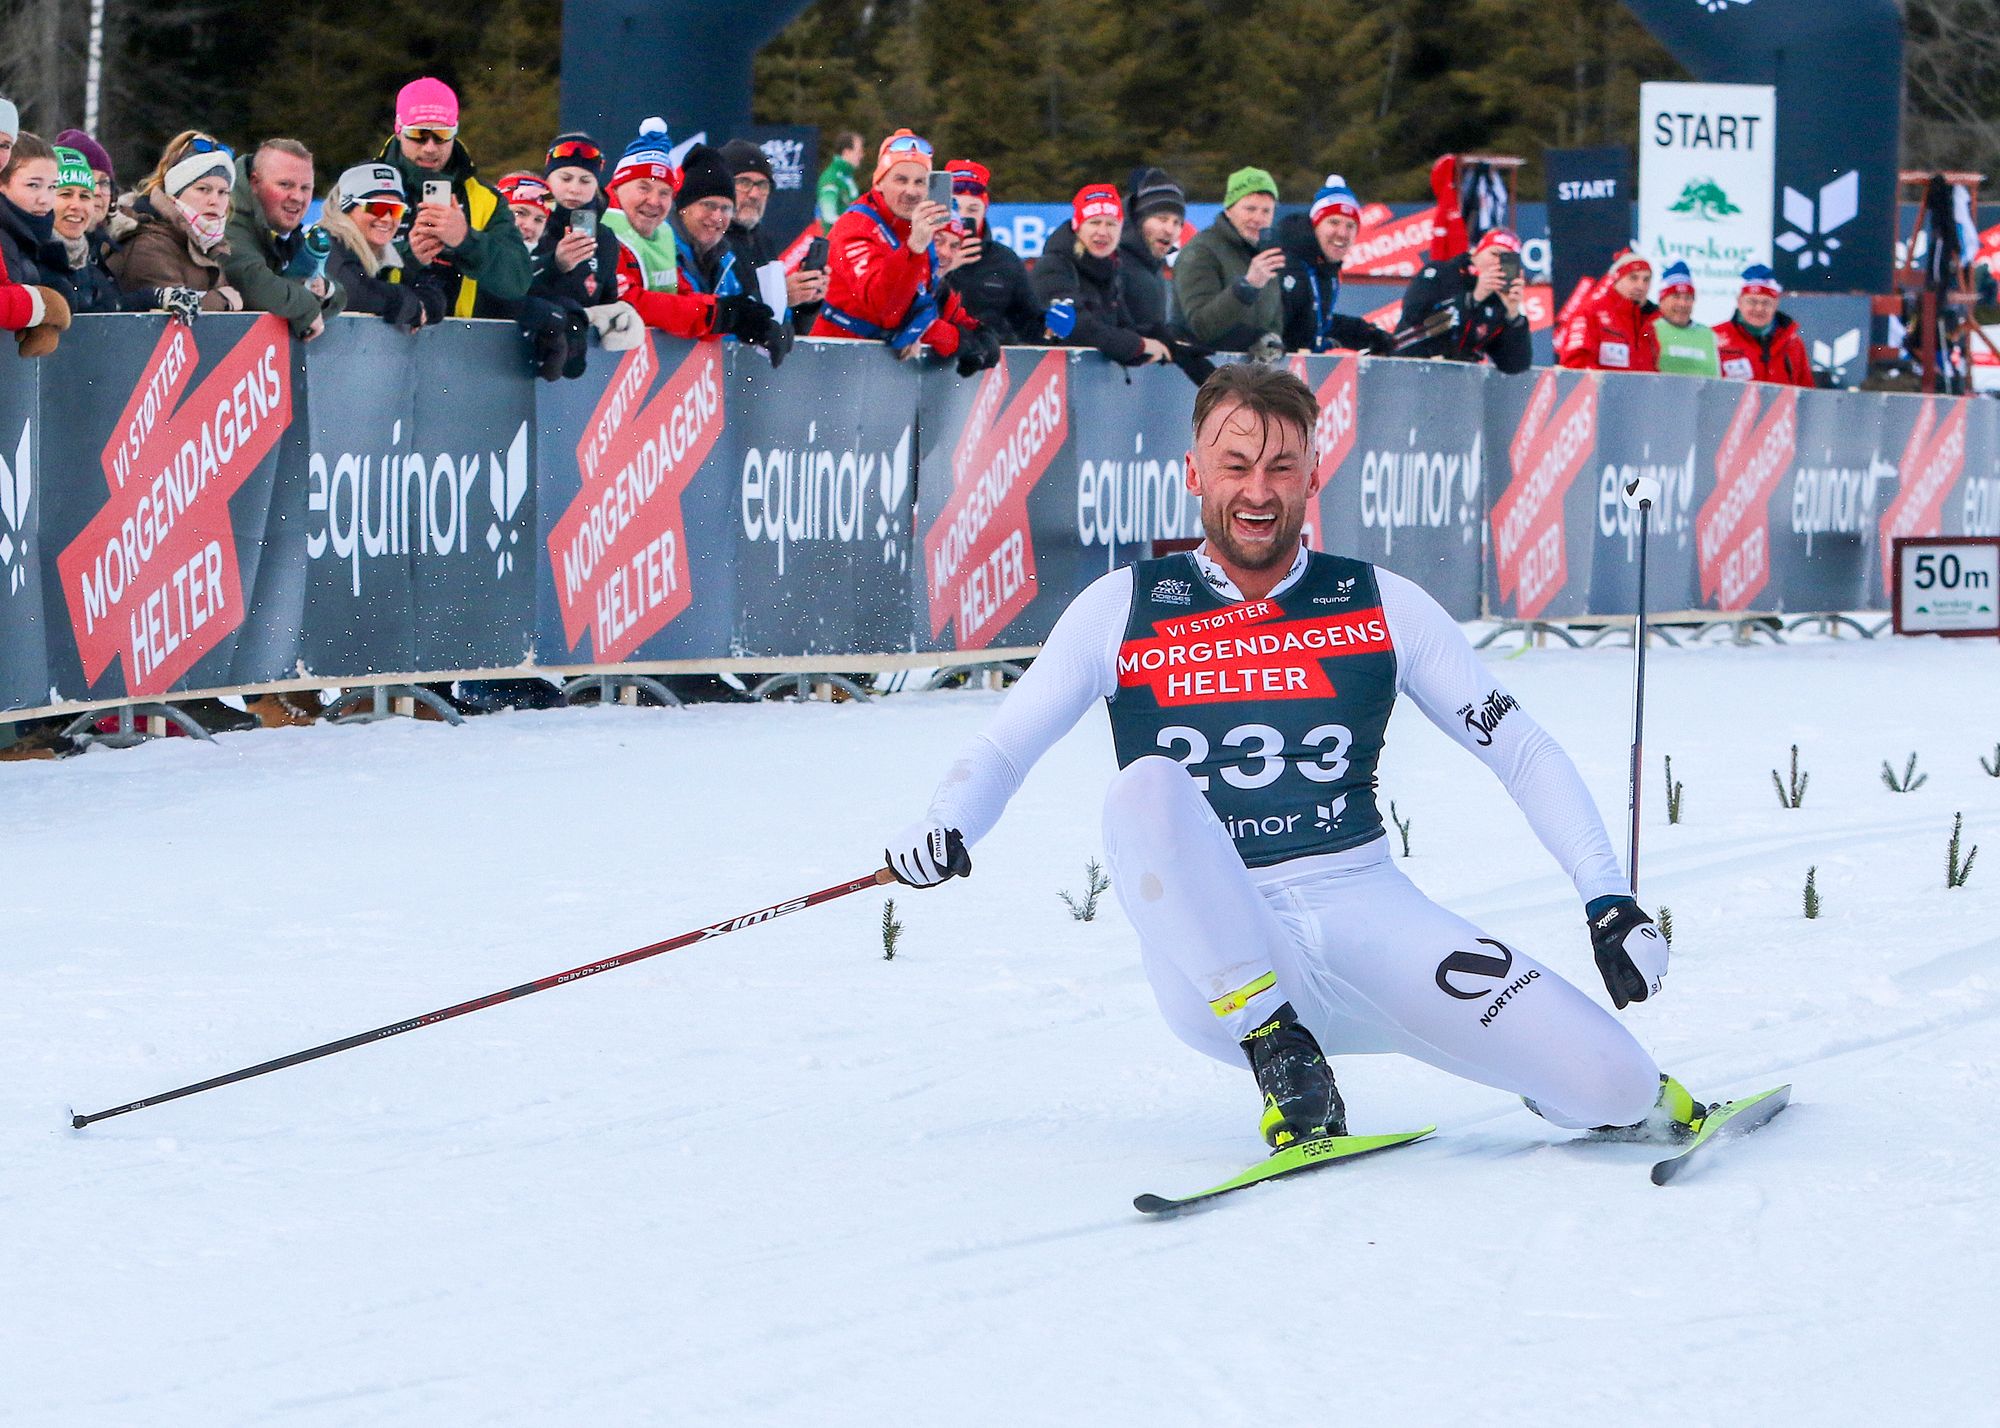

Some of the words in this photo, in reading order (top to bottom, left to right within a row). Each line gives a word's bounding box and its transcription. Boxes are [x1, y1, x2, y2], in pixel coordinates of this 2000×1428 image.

[1655, 112, 1761, 150] START
[1558, 179, 1616, 201] START
[113, 446, 131, 489] VI
[130, 331, 187, 462] STØTTER
[584, 443, 598, 479] VI
[597, 341, 650, 457] STØTTER
[81, 343, 281, 636] MORGENDAGENS
[562, 358, 717, 608] MORGENDAGENS
[742, 421, 875, 576] equinor
[934, 373, 1062, 599] MORGENDAGENS
[1361, 429, 1460, 556] equinor
[130, 540, 224, 686] HELTER
[595, 529, 677, 654] HELTER
[960, 528, 1026, 642] HELTER
[1313, 596, 1351, 605] equinor
[1119, 620, 1385, 676] MORGENDAGENS
[1167, 624, 1186, 637] VI
[1190, 602, 1270, 634] STØTTER
[1168, 667, 1308, 698] HELTER
[1456, 703, 1473, 717] TEAM
[1156, 724, 1353, 791] 233
[557, 972, 582, 983] AERO
[595, 959, 621, 973] TRIAC
[1480, 969, 1541, 1028] NORTHUG
[1303, 1139, 1335, 1159] FISCHER
